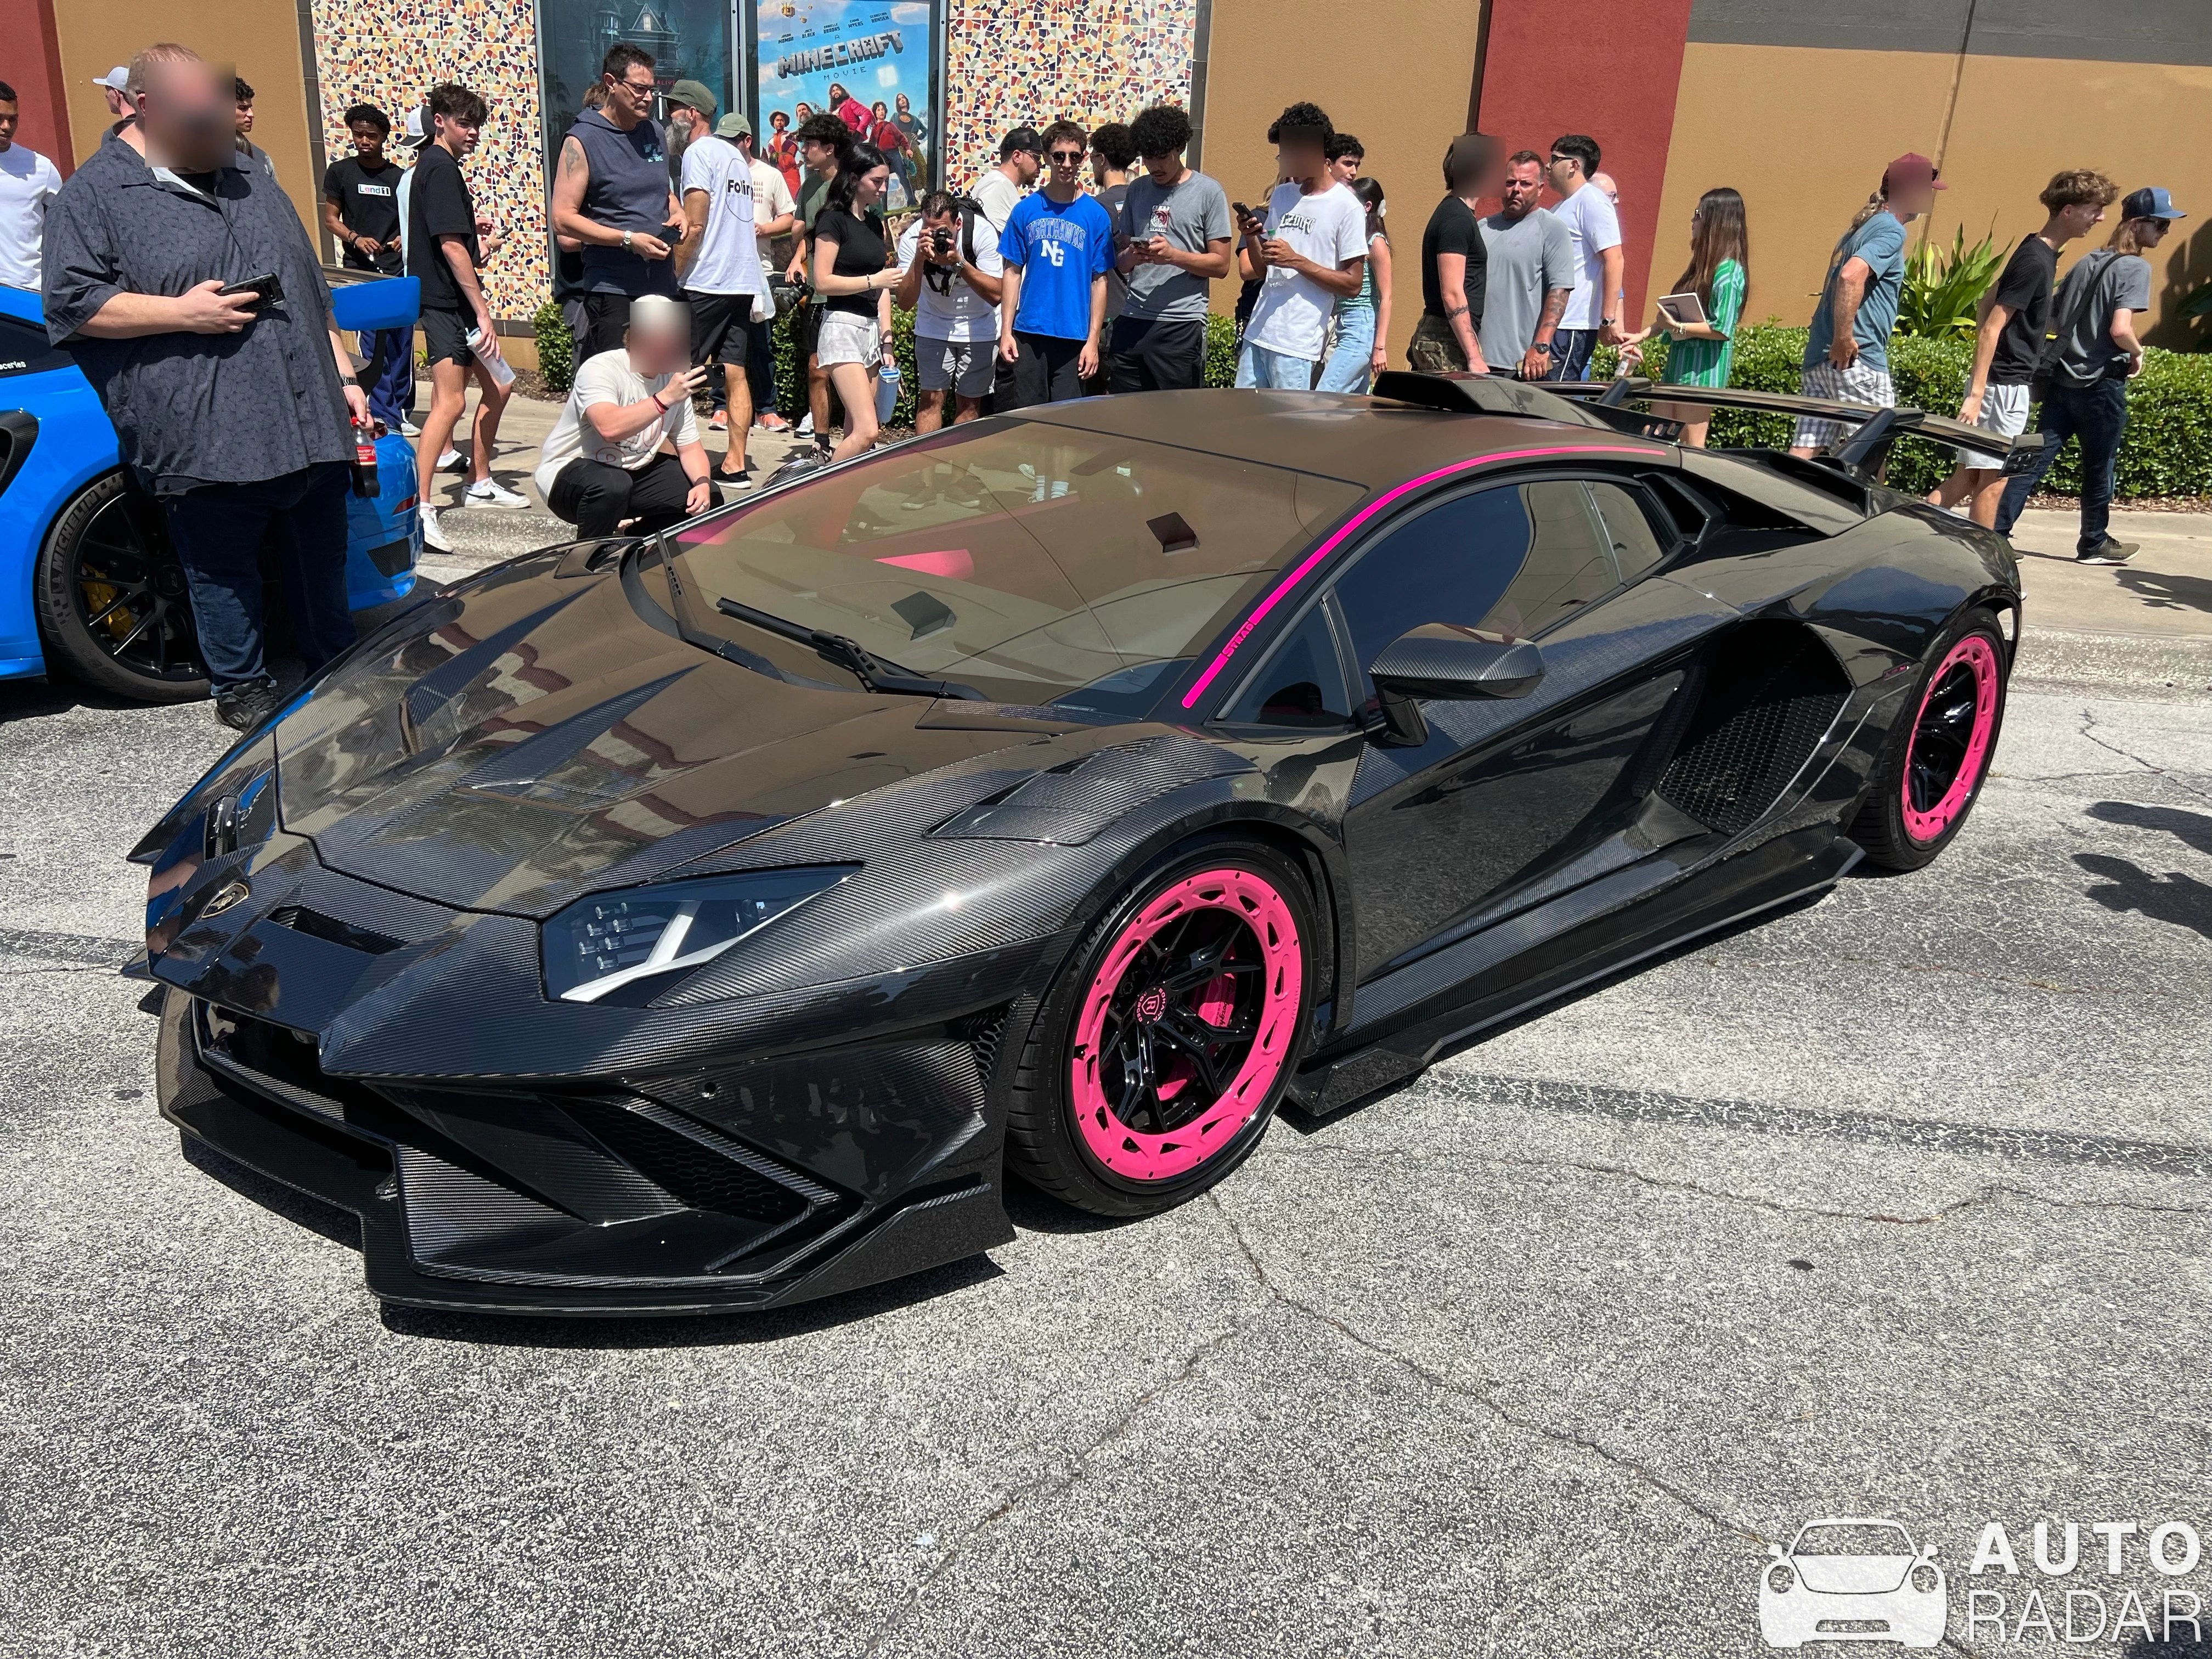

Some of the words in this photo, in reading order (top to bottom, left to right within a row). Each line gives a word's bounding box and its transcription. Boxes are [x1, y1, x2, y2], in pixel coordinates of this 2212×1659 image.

[778, 30, 904, 79] MINECRAFT
[823, 66, 867, 81] MOVIE
[1041, 239, 1064, 267] NG
[52, 490, 98, 572] MICHELIN
